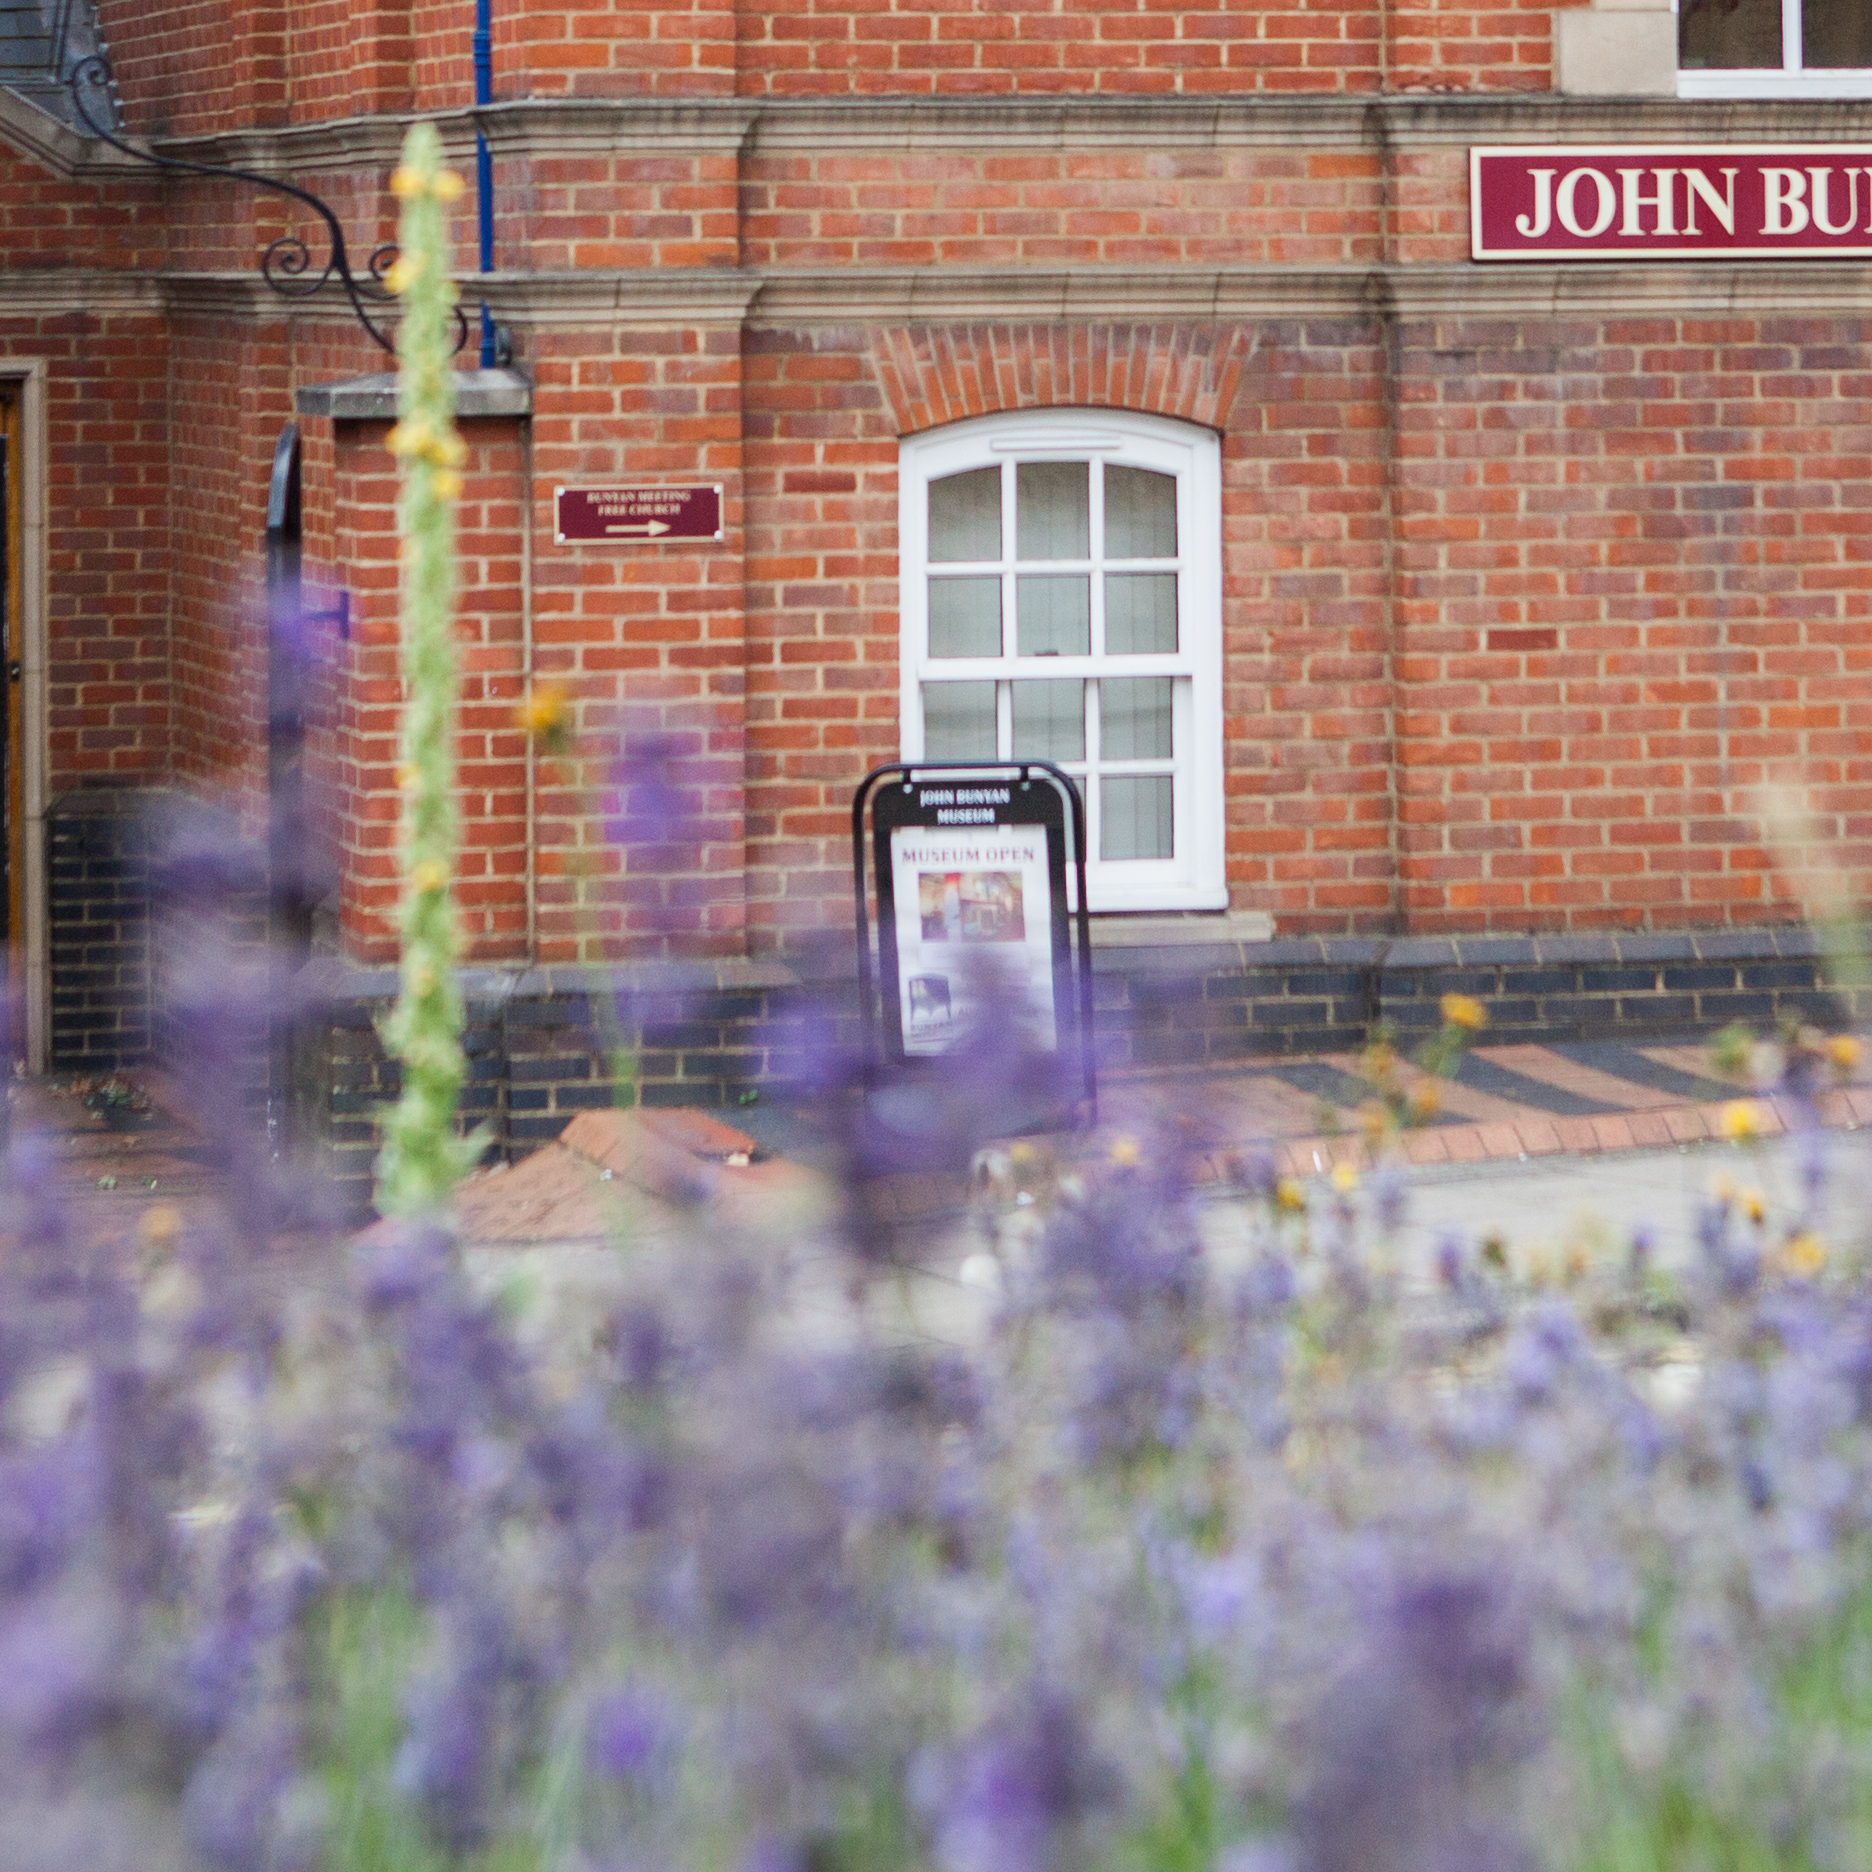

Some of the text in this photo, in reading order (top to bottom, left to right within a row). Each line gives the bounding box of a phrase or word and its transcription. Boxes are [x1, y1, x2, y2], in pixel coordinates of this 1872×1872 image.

[1515, 166, 1739, 238] JOHN
[587, 490, 691, 504] BUNYAN MEETING
[598, 504, 681, 517] FREE CHURCH
[920, 788, 1010, 808] JOHN BUNYAN
[937, 808, 995, 825] MUSEUM
[902, 846, 1035, 865] MUSEUM OPEN
